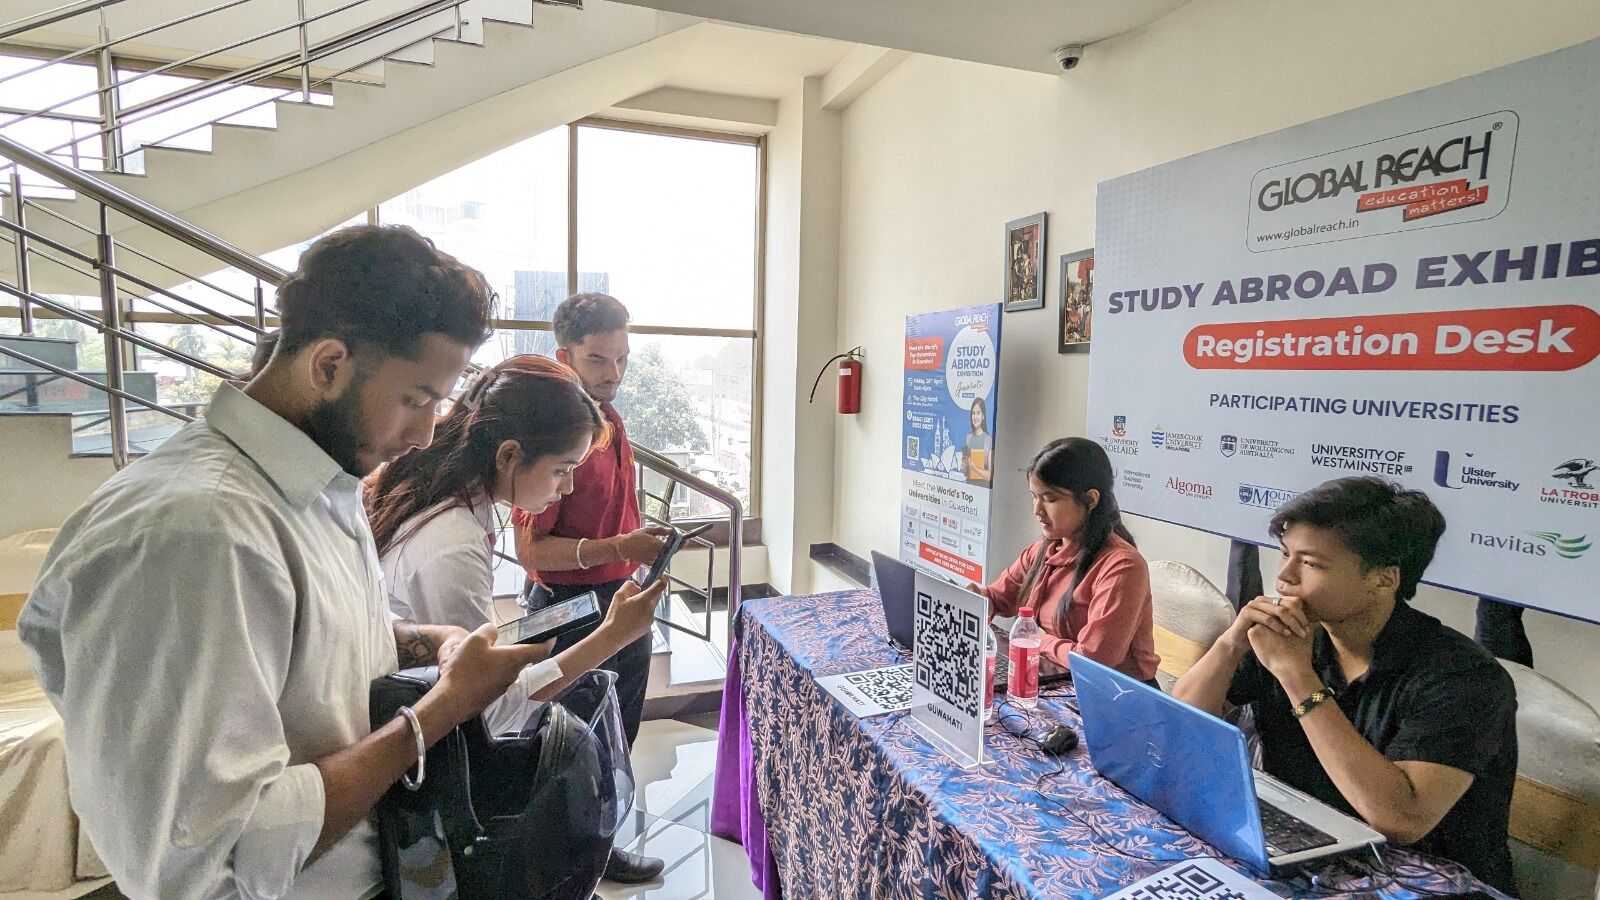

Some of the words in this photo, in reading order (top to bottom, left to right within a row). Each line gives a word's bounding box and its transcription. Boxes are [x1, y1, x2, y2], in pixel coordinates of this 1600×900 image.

[1258, 160, 1368, 212] GLOBAL
[1373, 131, 1492, 188] REACH
[1365, 184, 1460, 206] education
[1408, 188, 1481, 217] matters!
[1256, 218, 1359, 243] www.globalreach.in
[1107, 281, 1204, 315] STUDY
[1212, 262, 1398, 307] ABROAD
[1415, 238, 1600, 290] EXHIB
[956, 345, 986, 357] STUDY
[1196, 325, 1419, 364] Registration
[1435, 318, 1577, 356] Desk
[951, 358, 990, 370] ABROAD
[1208, 393, 1348, 416] PARTICIPATING
[1351, 398, 1520, 424] UNIVERSITIES
[1183, 434, 1203, 442] COOK
[1240, 438, 1280, 447] UNIVERSITY
[1240, 450, 1274, 458] AUSTRALIA
[1249, 445, 1295, 455] WOLLONGONG
[1311, 443, 1384, 460] UNIVERSITY
[1385, 450, 1405, 462] OF
[1311, 455, 1403, 475] WESTMINSTER
[1462, 466, 1496, 478] Ulster
[926, 481, 936, 490] the
[936, 485, 960, 499] World's
[961, 491, 974, 503] Top
[1165, 475, 1213, 496] Algoma
[1461, 475, 1520, 492] University
[1541, 487, 1558, 496] LA
[908, 488, 941, 504] Universities
[941, 498, 948, 507] in
[948, 500, 978, 517] Guwahati
[1470, 532, 1546, 556] navitas
[927, 702, 963, 731] GUWAHATI
